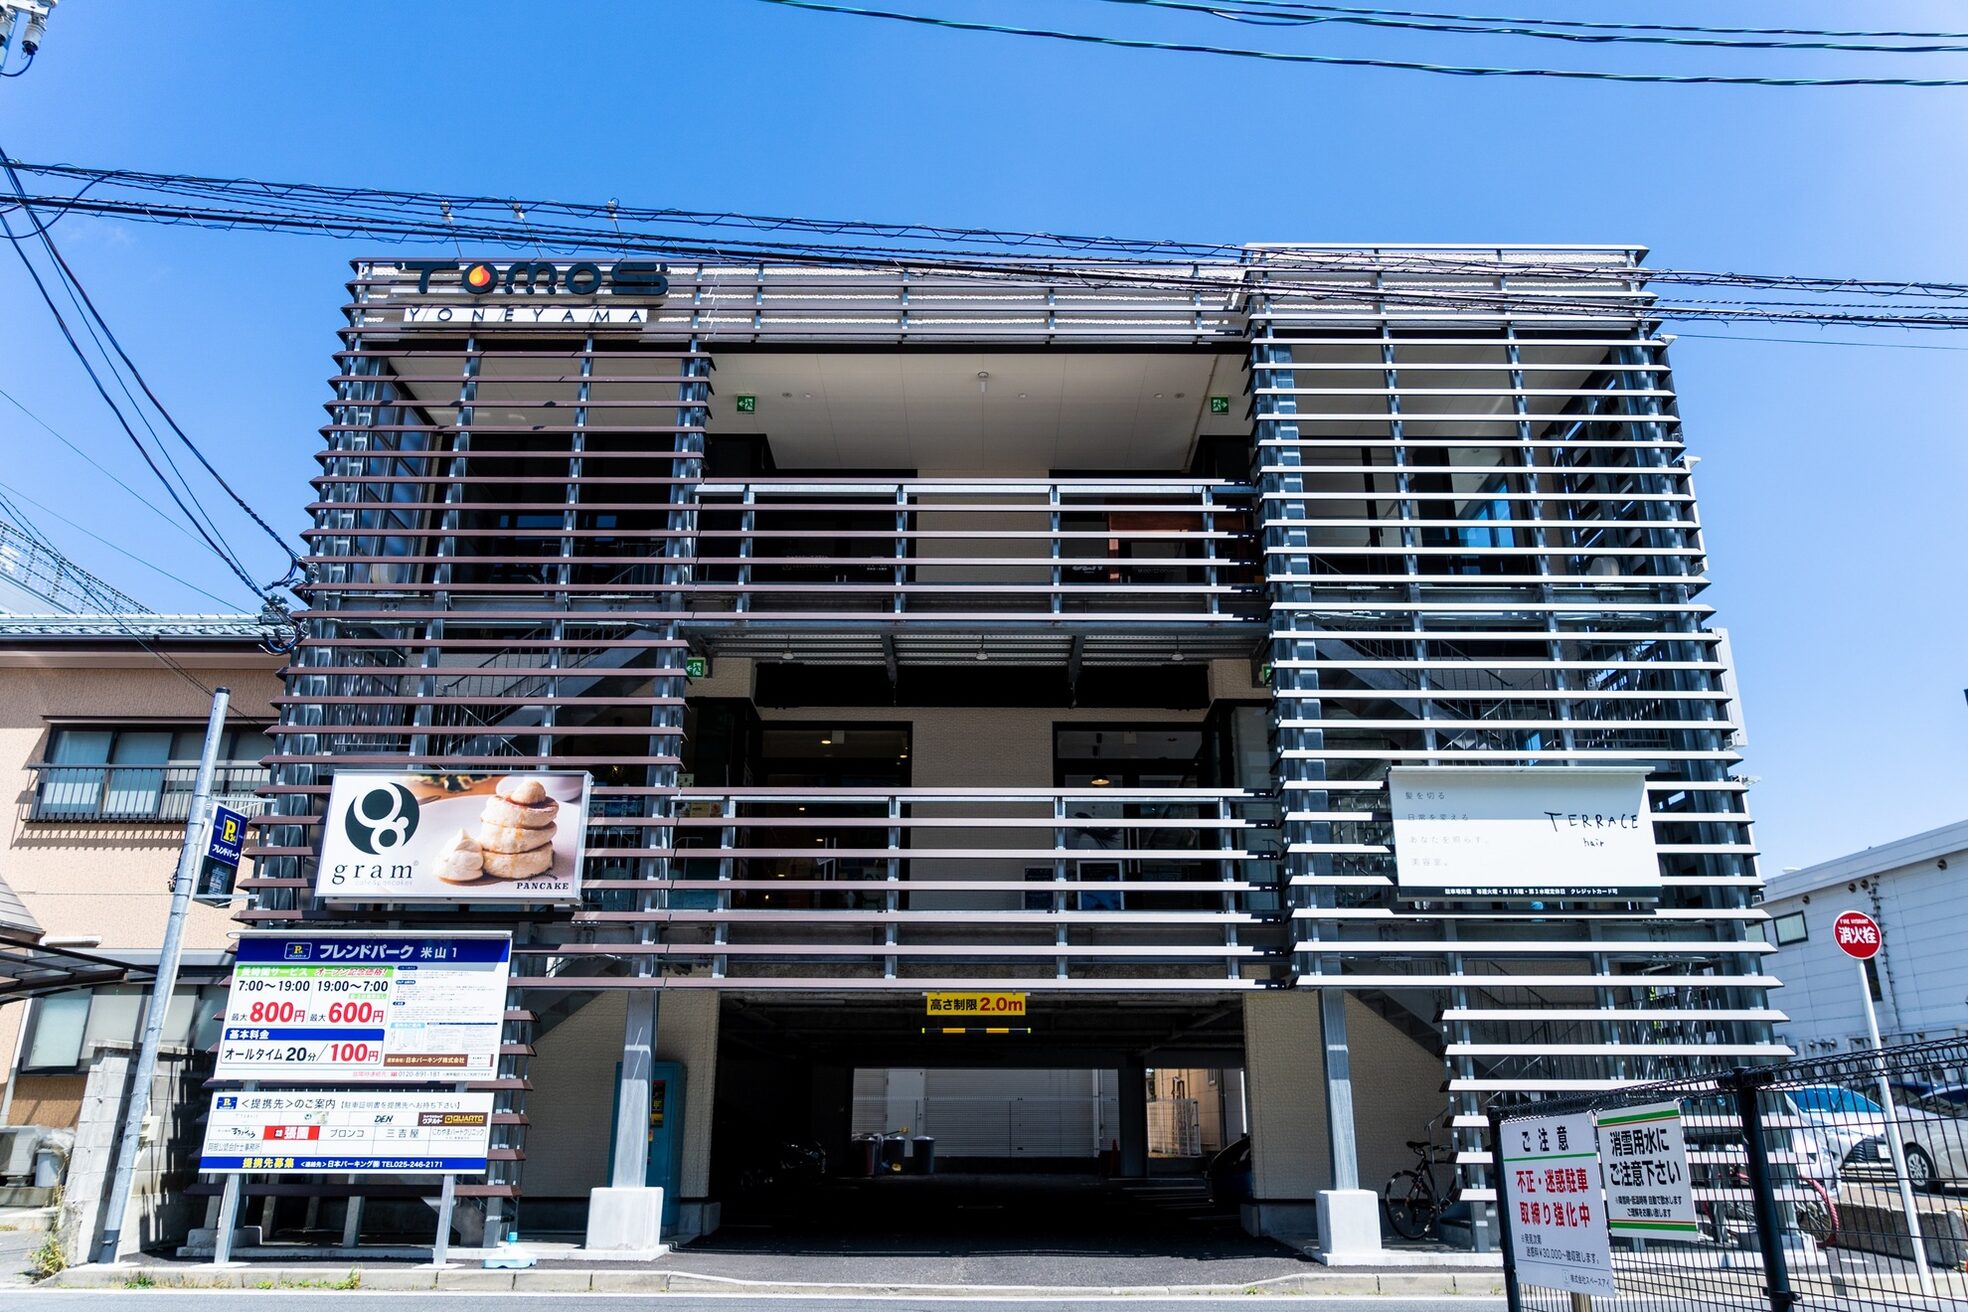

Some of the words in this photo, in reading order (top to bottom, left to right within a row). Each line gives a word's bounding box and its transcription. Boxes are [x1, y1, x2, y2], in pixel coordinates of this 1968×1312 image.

[409, 308, 642, 322] YONEYAMA
[1544, 811, 1639, 832] TERRACE
[1583, 837, 1605, 848] hair
[212, 844, 240, 860] フレンドパーク
[332, 864, 413, 885] gram
[516, 882, 569, 890] PANCAKE
[1838, 926, 1878, 944] 消火栓
[319, 944, 414, 959] フレンドパーク
[420, 946, 447, 959] 米山
[930, 998, 977, 1011] 高さ制限
[980, 996, 1023, 1012] 2.0m
[229, 1029, 270, 1040] 基本料金
[374, 1115, 394, 1123] DEN
[330, 1129, 365, 1138] ブロンコ
[386, 1129, 419, 1138] 三吉屋
[1521, 1125, 1569, 1152] ご注意
[1610, 1127, 1670, 1157] 消雪用水に
[242, 1157, 295, 1169] 提携先募集
[1516, 1168, 1589, 1194] 不正・迷惑駐車
[1609, 1159, 1682, 1187] ご注意下さい
[1519, 1201, 1591, 1228] 取締り強化中
